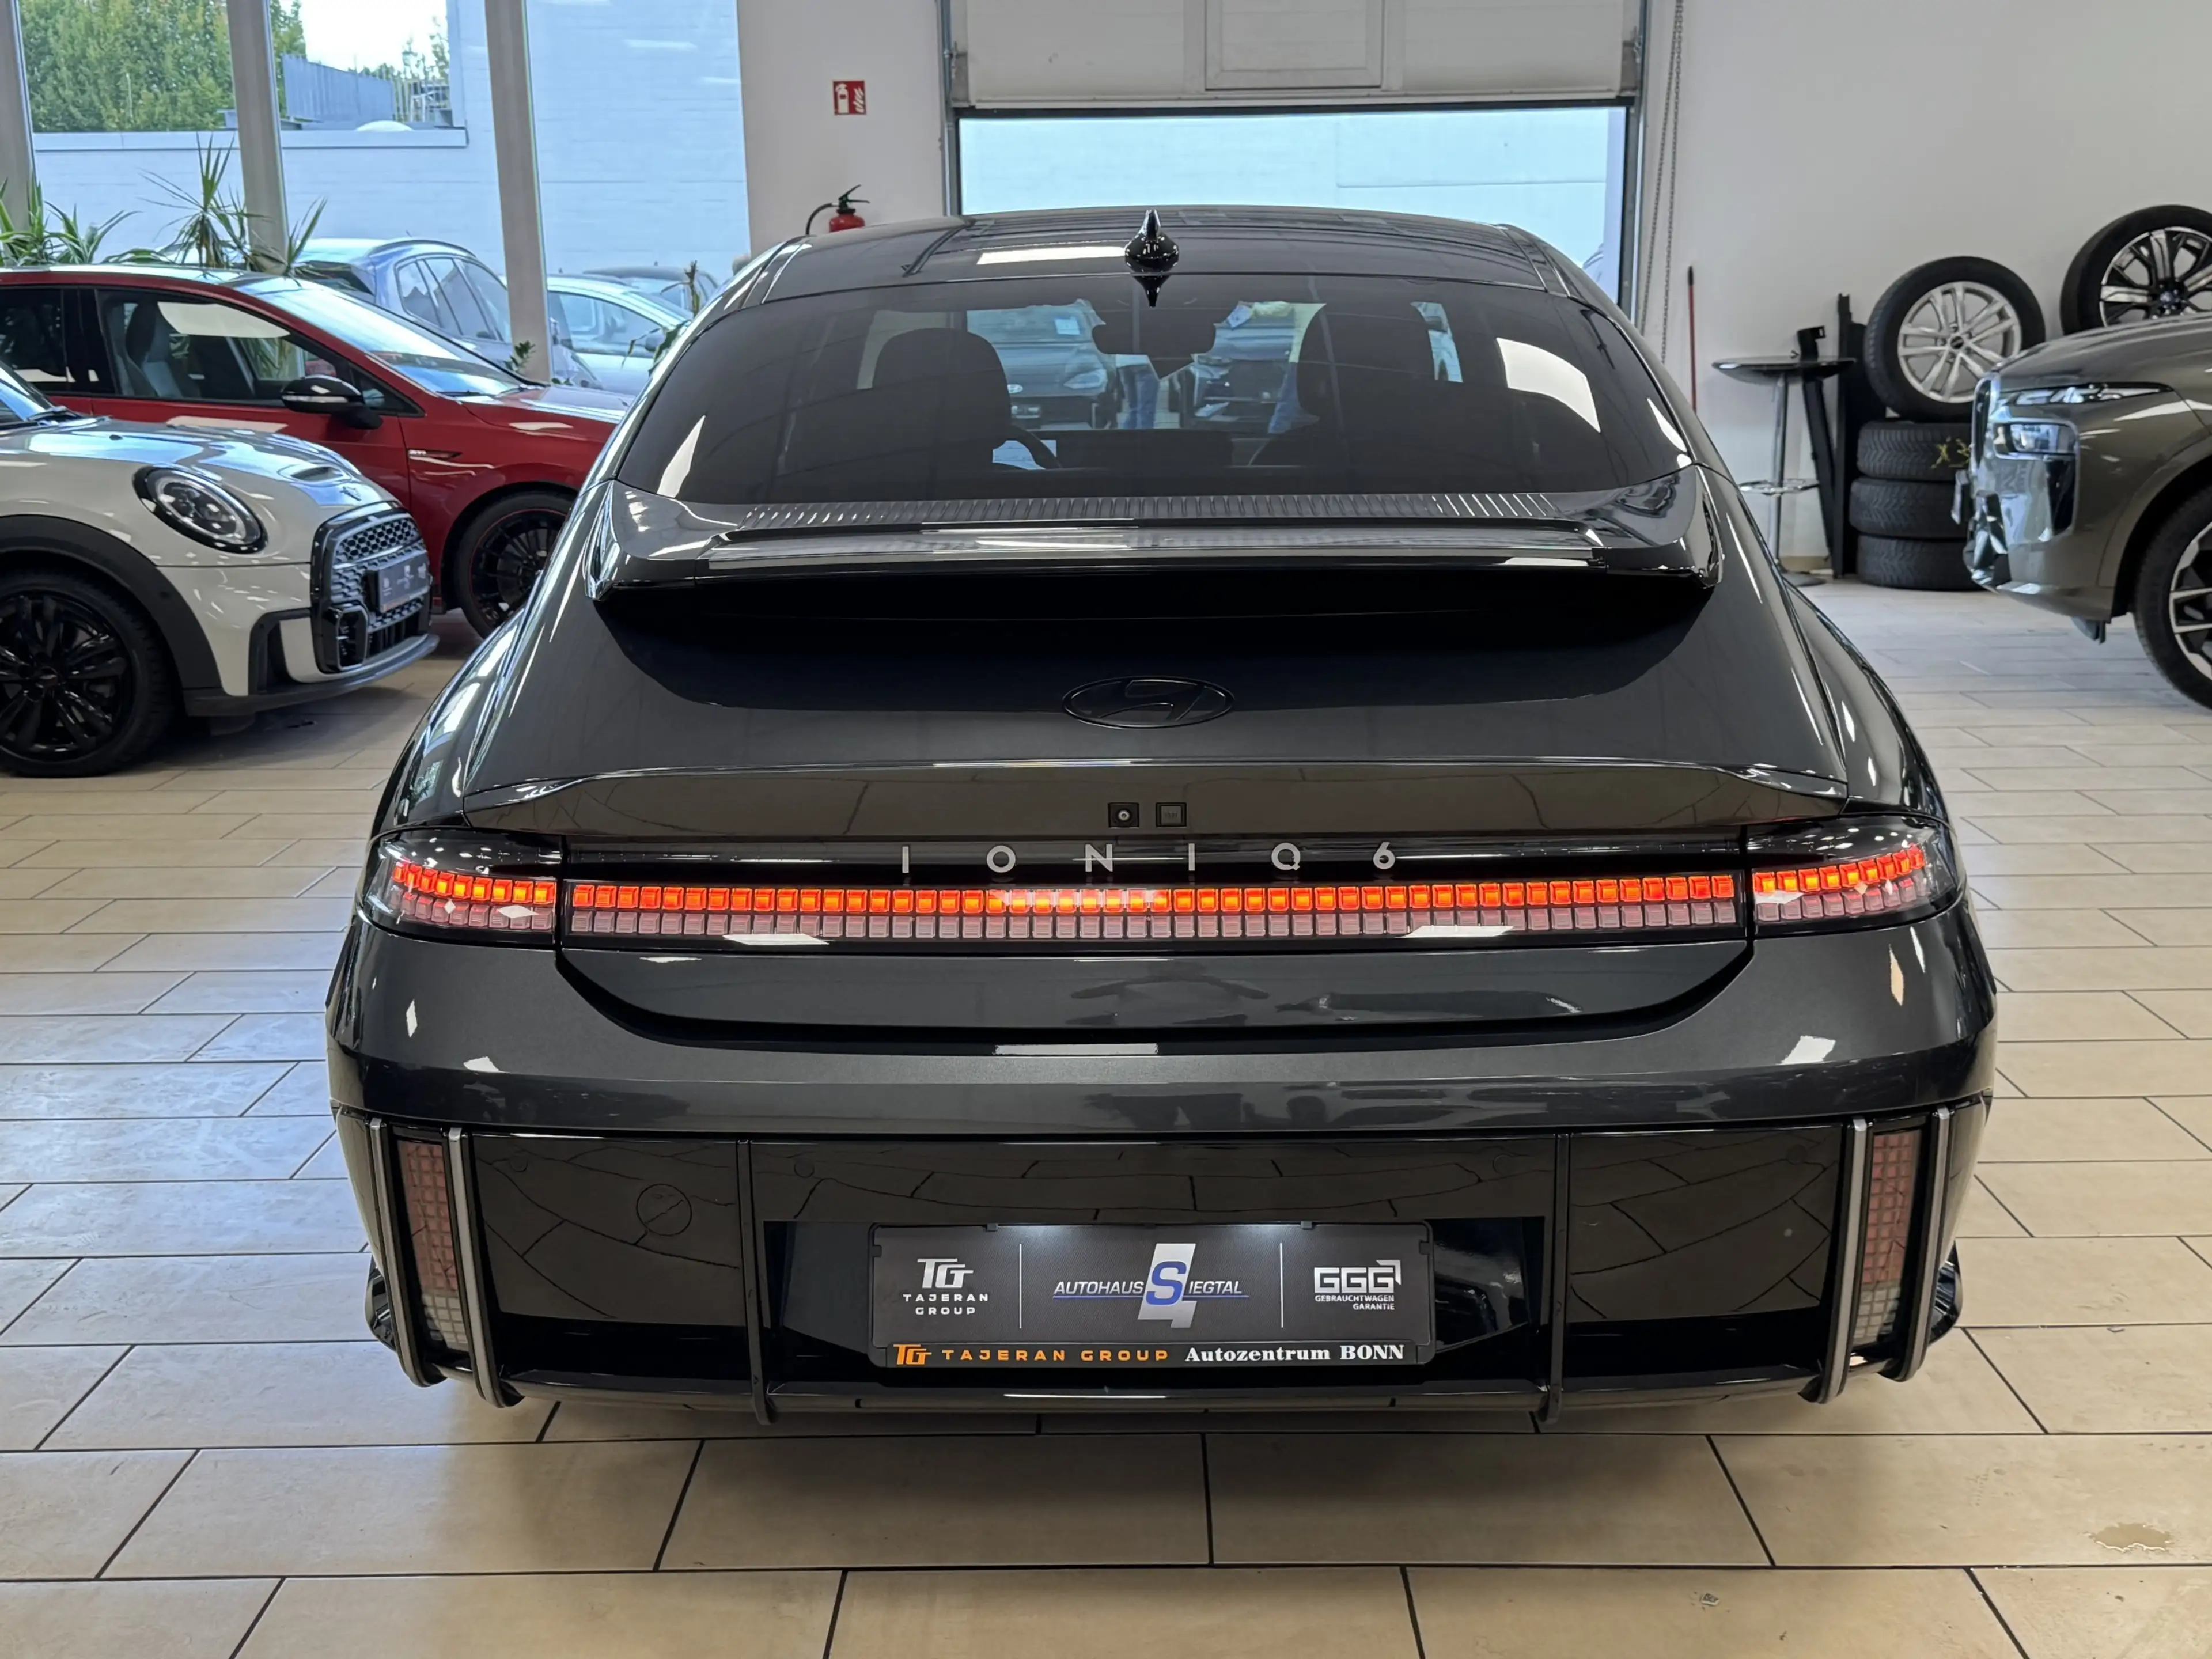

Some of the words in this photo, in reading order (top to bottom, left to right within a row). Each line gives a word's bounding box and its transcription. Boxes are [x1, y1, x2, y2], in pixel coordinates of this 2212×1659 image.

[917, 1258, 974, 1289] TG
[1054, 1281, 1145, 1295] AUTOHAUS
[1146, 1260, 1242, 1306] SIEGTAL
[1314, 1267, 1394, 1293] GGG
[903, 1293, 988, 1302] TAJERAN
[915, 1306, 976, 1315] GROUP
[893, 1344, 932, 1365] TG
[942, 1349, 1065, 1361] TAJERAN
[1081, 1350, 1168, 1362] GROUP
[1185, 1346, 1330, 1362] Autozentrum
[1340, 1344, 1404, 1359] BONN
